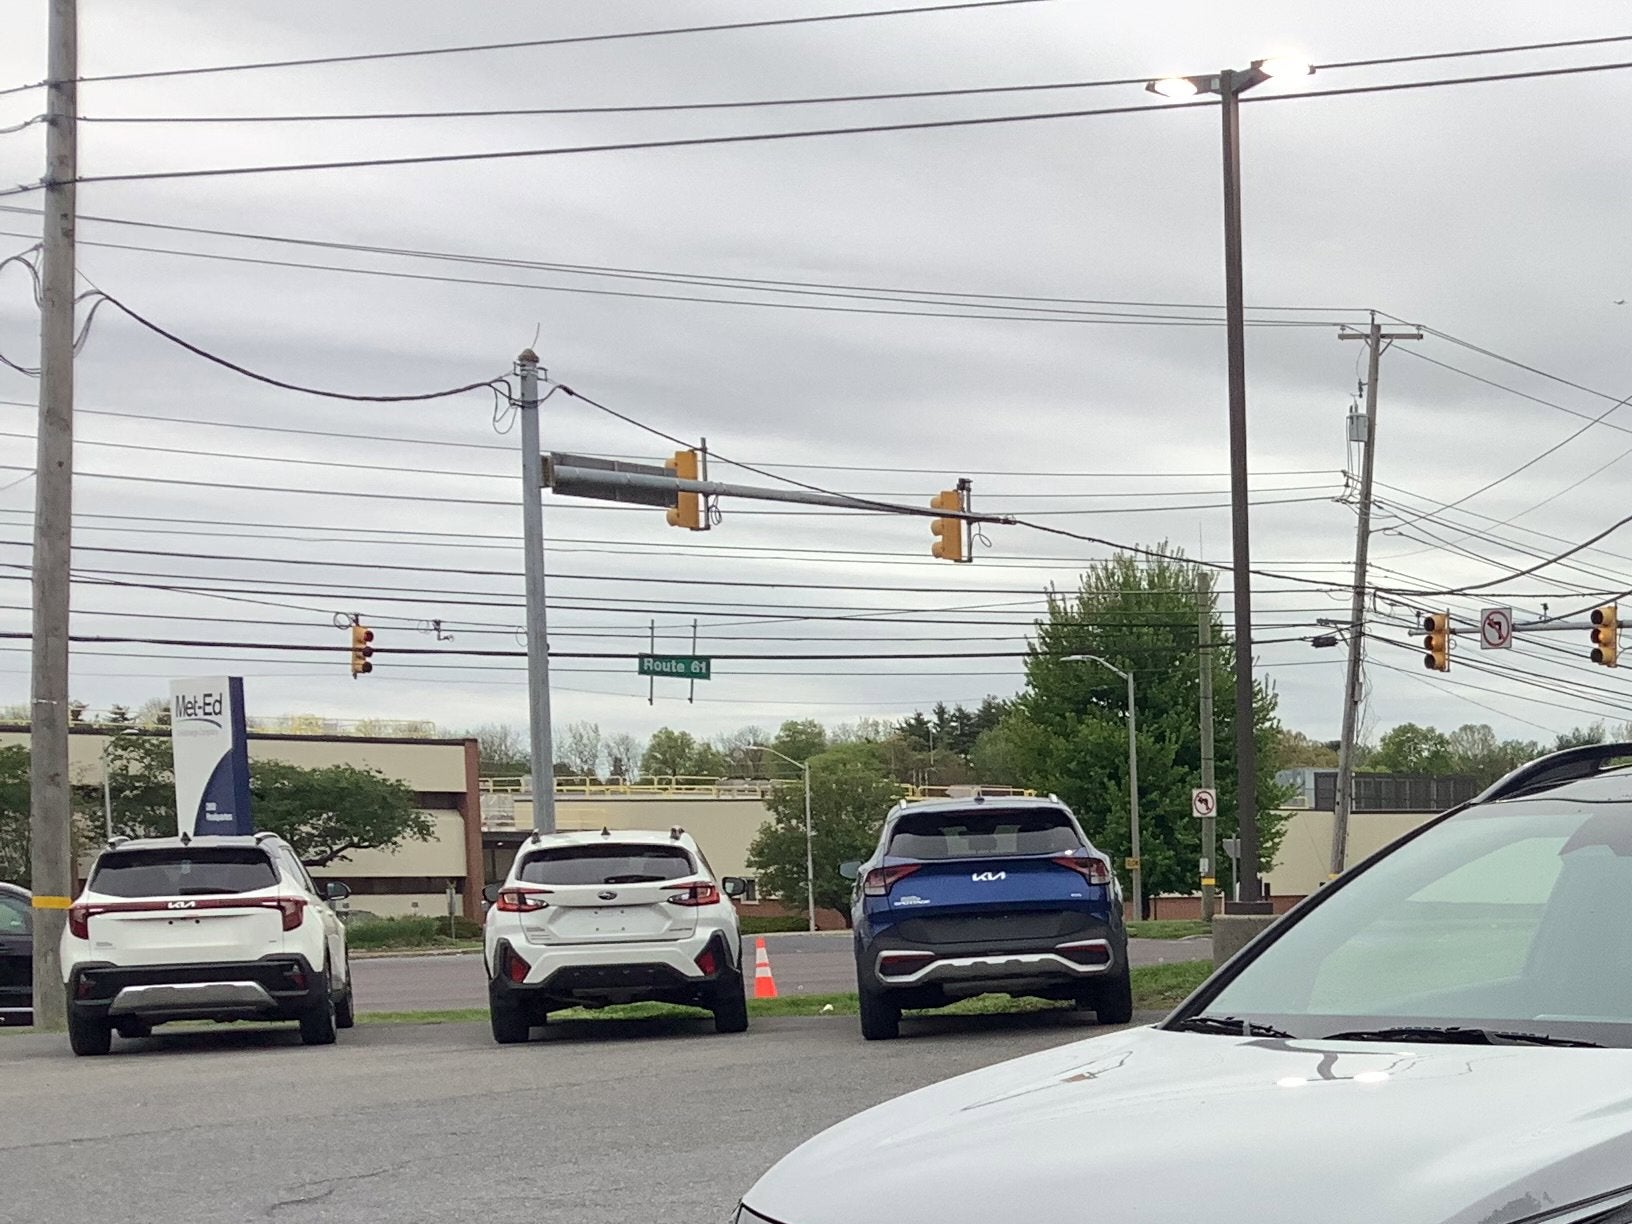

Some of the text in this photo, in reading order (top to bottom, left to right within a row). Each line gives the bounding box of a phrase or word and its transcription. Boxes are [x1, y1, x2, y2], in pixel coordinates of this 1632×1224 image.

[643, 658, 707, 673] Route 61
[176, 693, 222, 717] Met-Ed
[972, 871, 1006, 882] KIA
[168, 901, 196, 909] KIA
